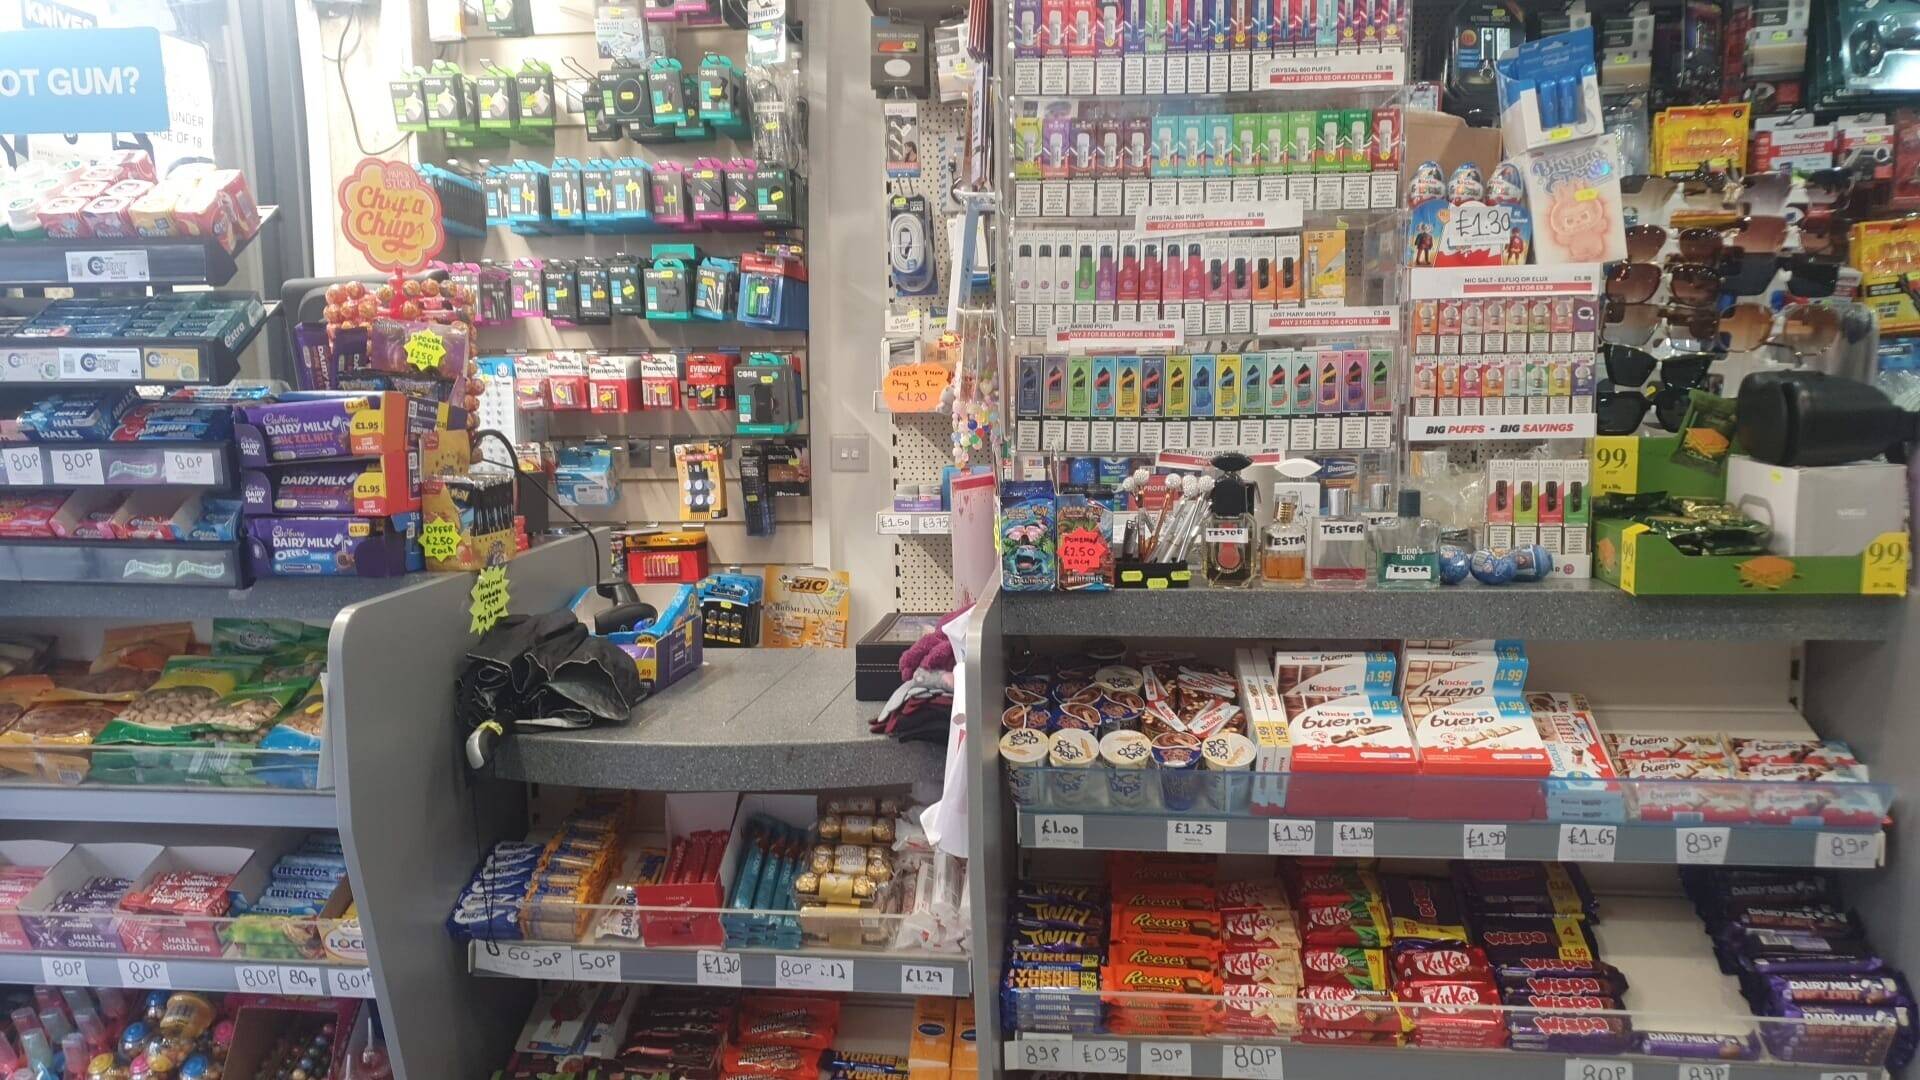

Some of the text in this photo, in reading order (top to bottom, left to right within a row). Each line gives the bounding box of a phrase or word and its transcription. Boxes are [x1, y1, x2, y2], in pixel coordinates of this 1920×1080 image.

[753, 8, 780, 19] PHILIPS
[48, 66, 140, 97] GUM?
[172, 111, 204, 129] UNDER
[177, 132, 190, 144] OF
[193, 135, 203, 148] 18
[1456, 209, 1510, 238] £1.30
[224, 321, 246, 350] extra
[590, 367, 625, 377] Panasonic
[642, 364, 677, 374] Panasonic
[737, 370, 758, 379] CORE
[263, 412, 299, 426] Cadbury
[355, 421, 379, 431] £1.95
[40, 429, 80, 440] HALLS
[265, 419, 333, 436] DAIRY MILK
[1426, 425, 1446, 435] BIG
[1448, 424, 1485, 434] PUFFS
[1500, 424, 1520, 433] BIG
[1522, 423, 1575, 433] SAVINGS
[241, 442, 261, 450] DAIRY
[281, 475, 347, 486] DAIRY MILK
[245, 489, 266, 498] DAIRY
[357, 484, 380, 494] £1.95
[247, 496, 264, 504] MILK
[272, 525, 305, 539] Cadbury
[426, 525, 453, 535] OFFER
[1207, 529, 1244, 538] TESTOR
[1321, 523, 1364, 535] TESTER
[273, 537, 335, 549] DAIRY MILK
[274, 548, 310, 562] OREO
[1063, 545, 1096, 558] £2.50
[1396, 545, 1424, 556] Lion's
[791, 577, 828, 592] BIC
[1320, 653, 1353, 662] bueno
[1437, 678, 1471, 687] Kinder
[1418, 684, 1485, 698] bueno
[1316, 710, 1350, 718] Kinder
[1430, 714, 1496, 728] bueno
[1441, 710, 1475, 718] Kinder
[1301, 716, 1372, 730] bueno
[1629, 735, 1670, 747] bueno
[1755, 741, 1799, 753] bueno
[1640, 761, 1681, 774] bueno
[1761, 765, 1806, 777] bueno
[1041, 819, 1079, 834] £1.00
[1174, 823, 1213, 835] £1.25
[1272, 824, 1314, 842] £1.99
[1338, 823, 1374, 841] £1.99
[1466, 829, 1507, 848] £1.99
[1567, 827, 1615, 847] £1.65
[1685, 831, 1723, 854] 89P
[1831, 836, 1870, 858] 89P
[277, 865, 330, 878] mentos
[270, 886, 324, 900] mentos
[1029, 903, 1091, 927] Twirl
[1132, 912, 1188, 929] Reese's
[1231, 913, 1274, 930] KitKat
[1312, 908, 1351, 924] KitKat
[68, 939, 117, 949] Soothers
[73, 933, 102, 943] HALLS
[167, 936, 198, 945] HALLS
[1020, 929, 1086, 948] Twirl
[1485, 931, 1548, 946] Wispa
[161, 942, 211, 952] Soothers
[579, 953, 616, 970] 50P
[1020, 952, 1082, 962] YORKIE
[1129, 948, 1186, 967] Reese's
[1229, 953, 1273, 971] KitKat
[1307, 954, 1348, 970] KitKat
[1421, 951, 1471, 972] KitKat
[52, 960, 82, 977] 80P
[129, 961, 161, 983] 80P
[780, 963, 812, 977] 80P
[244, 970, 277, 987] 80P
[906, 969, 943, 983] £1.29
[1015, 976, 1081, 989] YORKIE
[1123, 969, 1182, 988] Reese's
[1527, 977, 1600, 995] Wispa
[1789, 980, 1861, 991] DAIRY MILK
[1035, 993, 1071, 1002] ORIGINAL
[1427, 987, 1479, 1008] KitKat
[1529, 995, 1603, 1014] Wispa
[1035, 1004, 1071, 1013] ORIGINAL
[1534, 1016, 1609, 1035] Wispa
[1803, 1012, 1874, 1026] DAIRY MILK
[1649, 1032, 1716, 1044] DAIRY MILK
[841, 1051, 898, 1063] YORKIE
[1025, 1046, 1060, 1064] 89P
[1150, 1050, 1183, 1062] 90P
[1234, 1046, 1277, 1068] 80P
